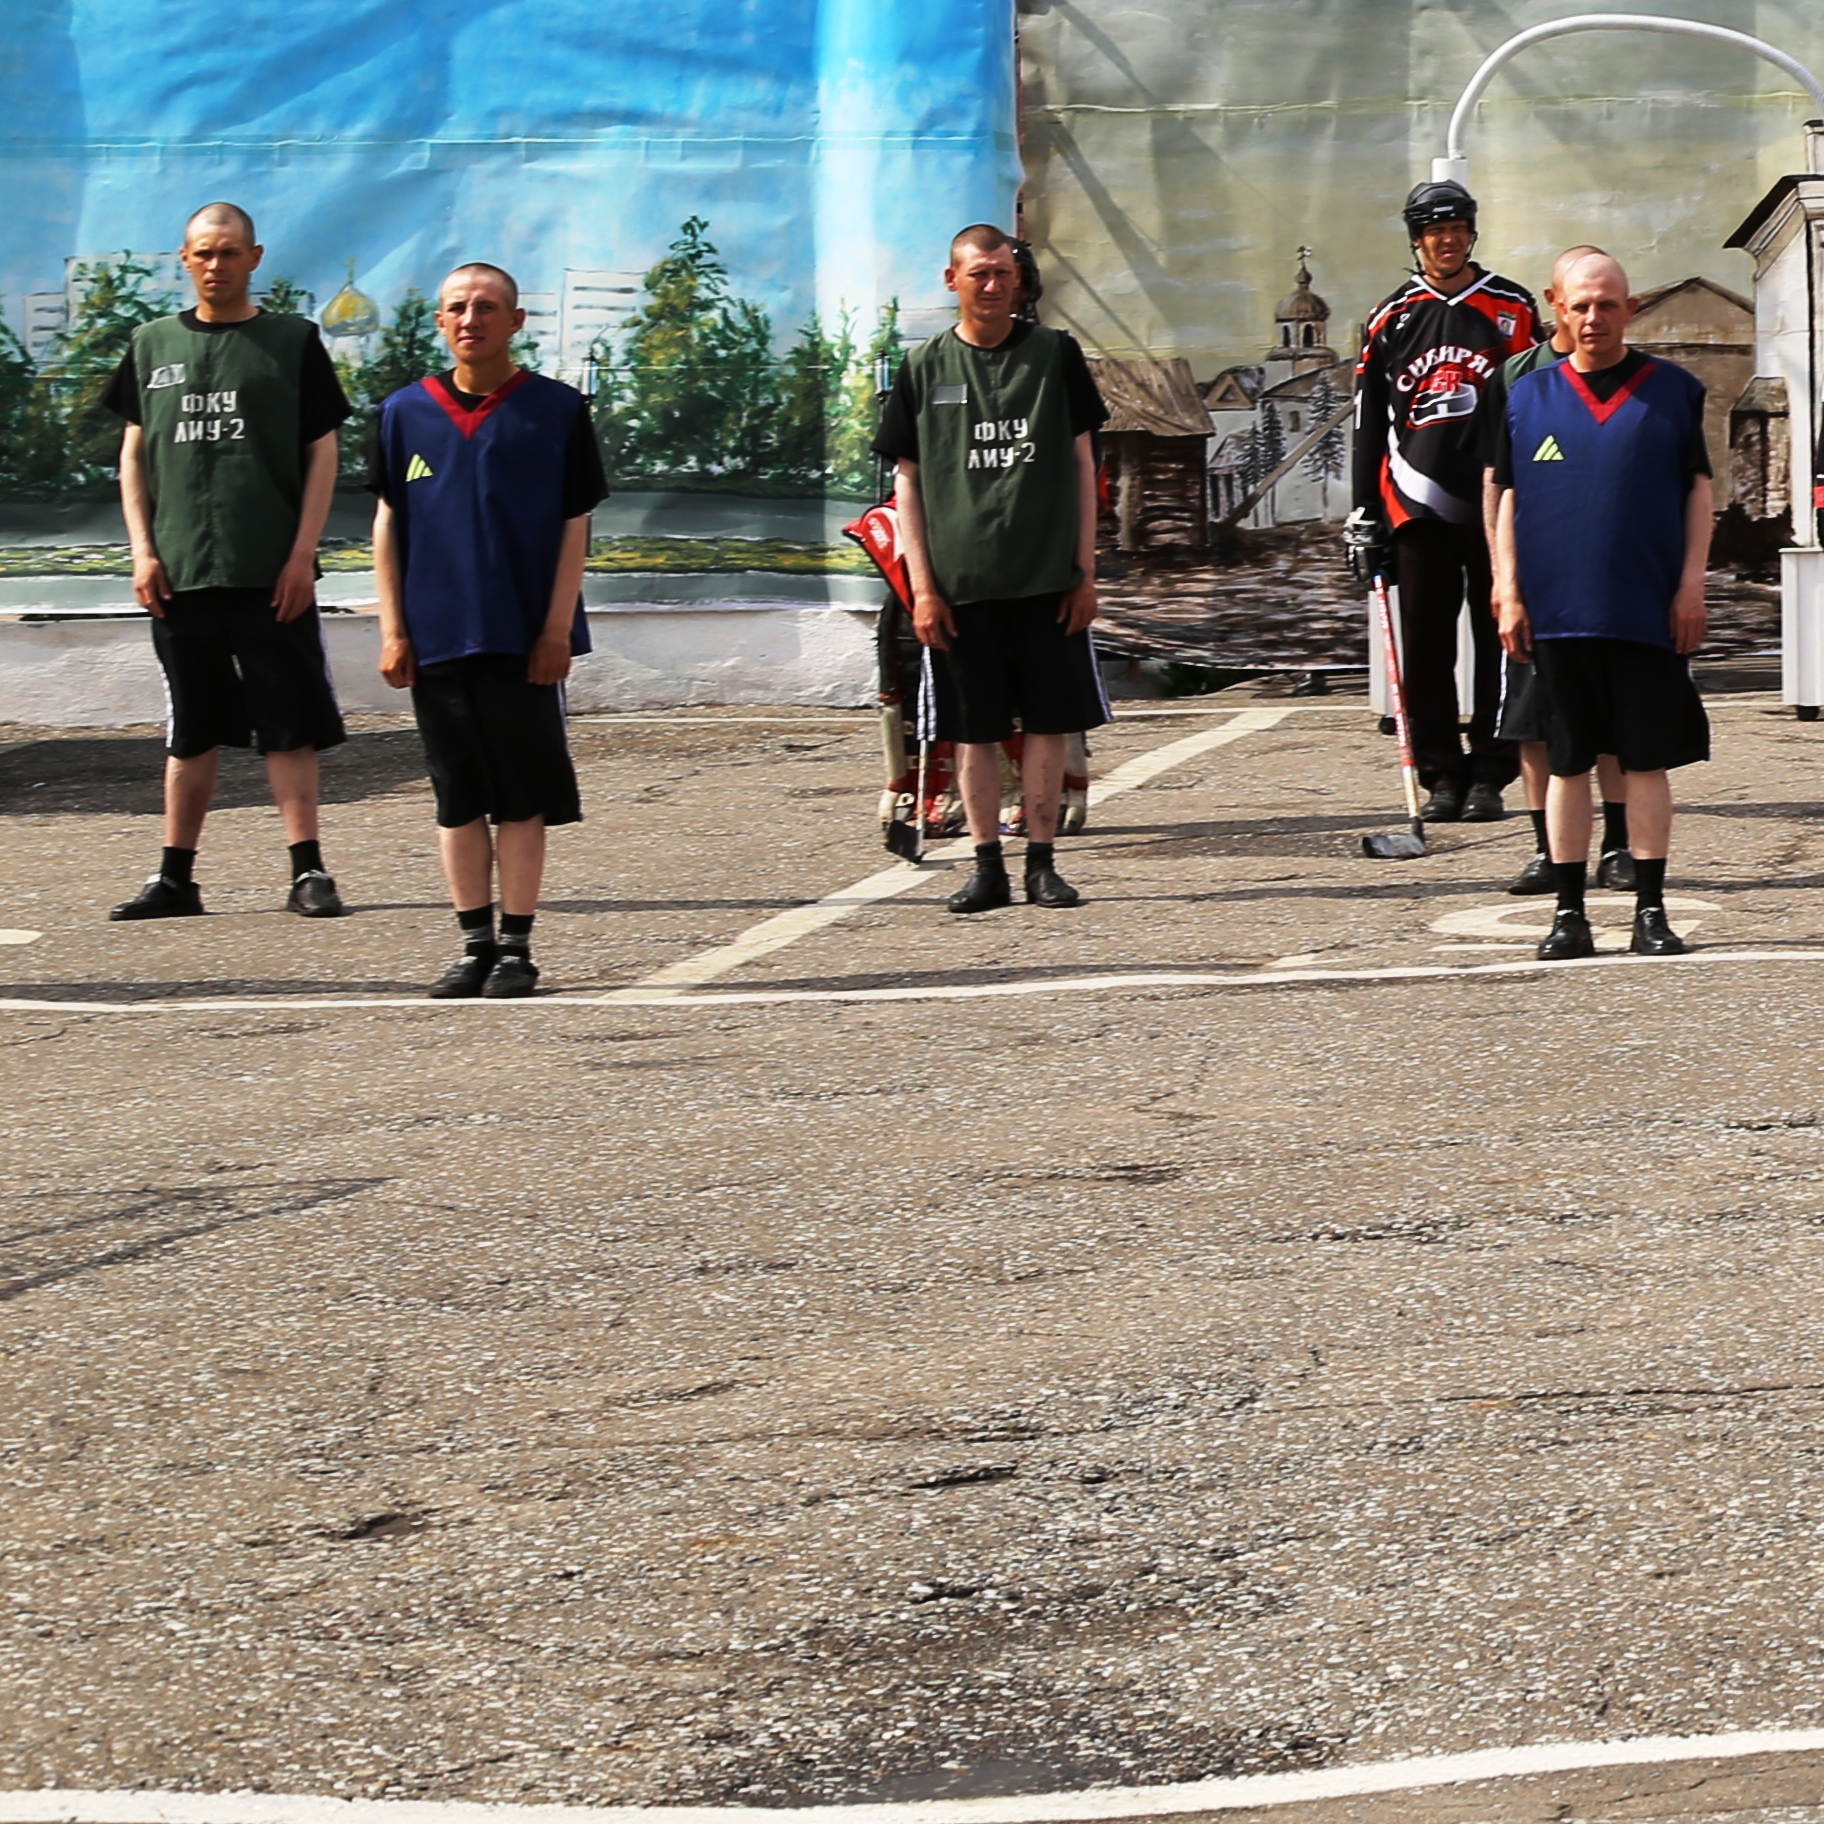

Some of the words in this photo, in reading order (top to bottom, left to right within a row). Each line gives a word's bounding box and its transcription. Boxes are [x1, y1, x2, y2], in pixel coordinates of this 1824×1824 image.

[1396, 344, 1496, 393] СИБИРЯ
[181, 390, 238, 414] ФКУ
[174, 418, 246, 444] ЛИУ-2
[974, 418, 1029, 442] ФКУ
[967, 441, 1037, 470] ЛИУ-2
